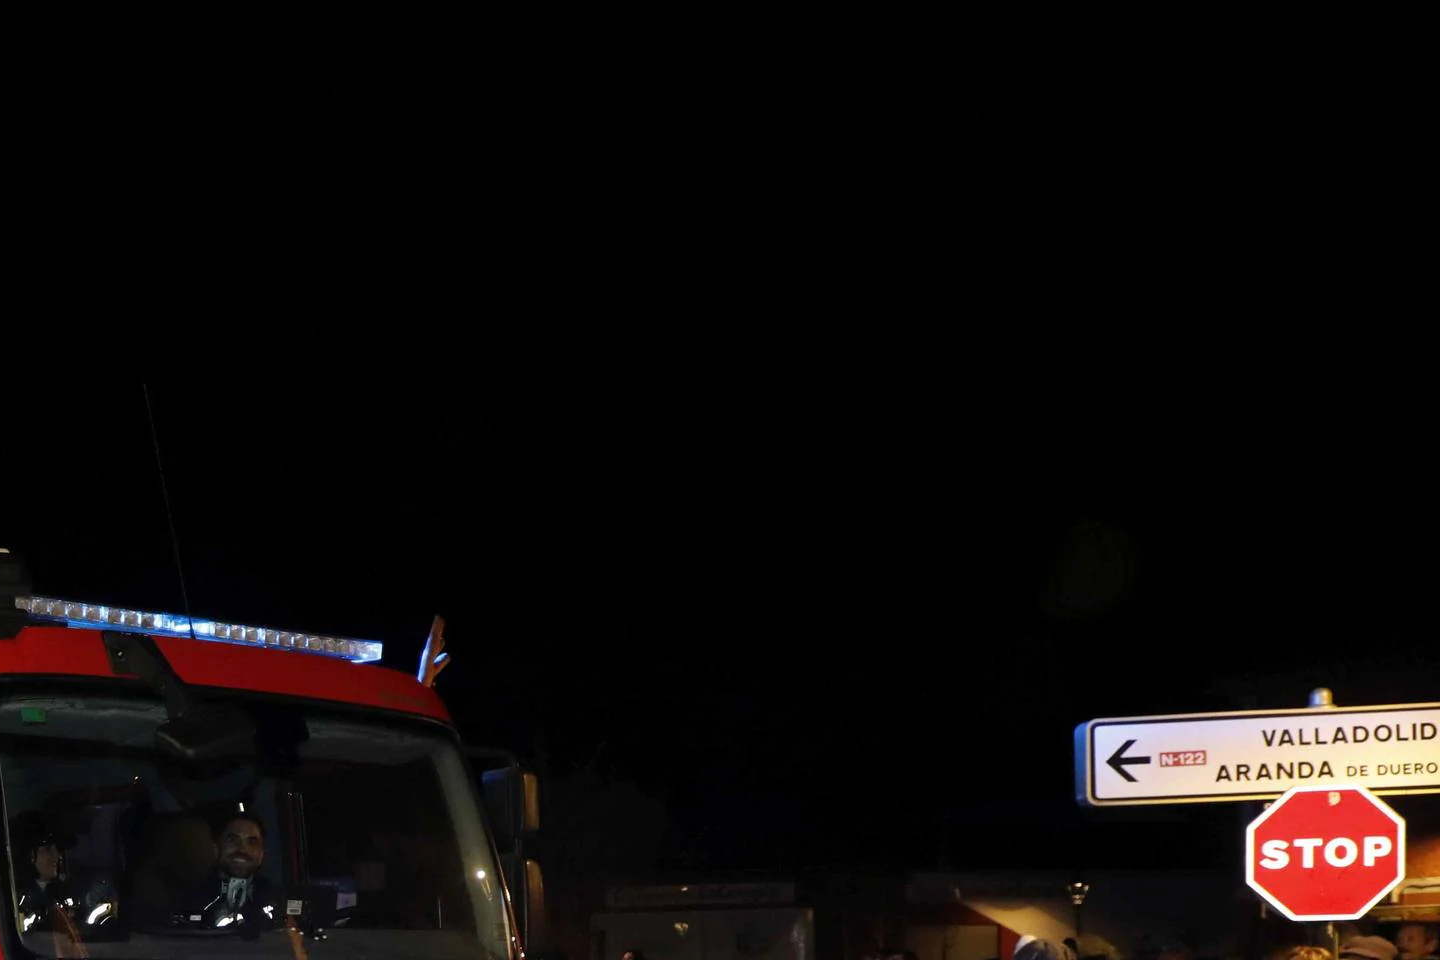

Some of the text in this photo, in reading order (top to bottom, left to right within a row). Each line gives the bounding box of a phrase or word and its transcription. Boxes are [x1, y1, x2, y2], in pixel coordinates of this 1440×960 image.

[1262, 722, 1437, 747] VALLADOLID
[1160, 752, 1206, 766] N-122
[1215, 761, 1438, 782] ARANDA DE DUERO
[1260, 836, 1392, 869] STOP
